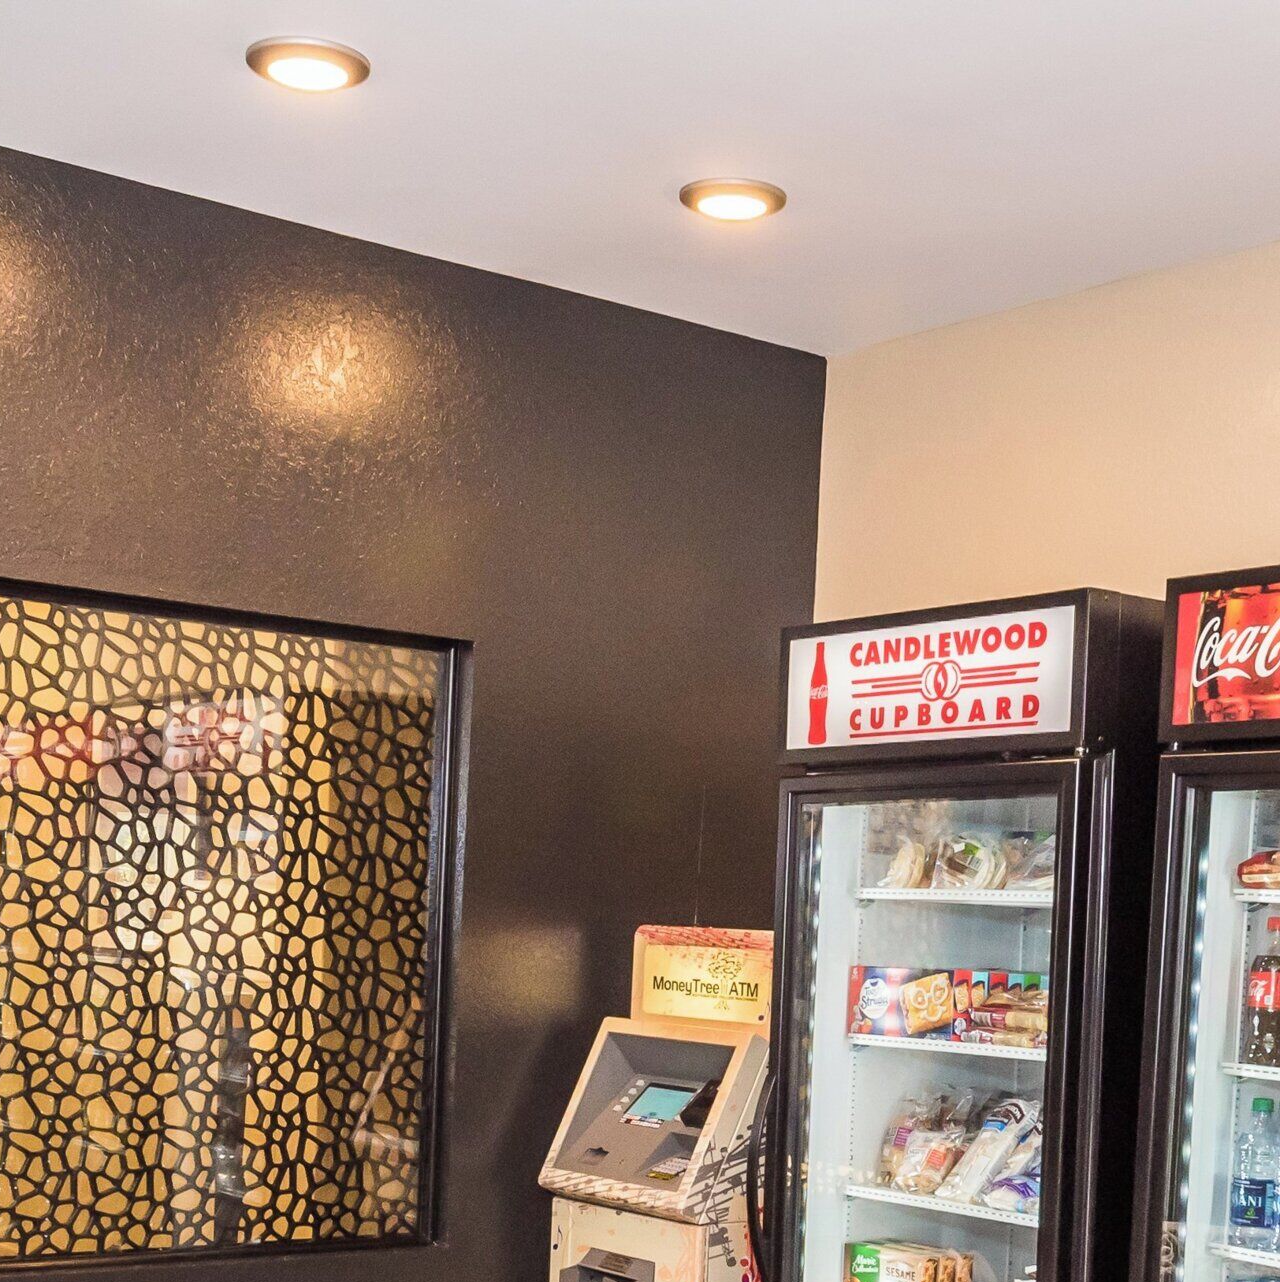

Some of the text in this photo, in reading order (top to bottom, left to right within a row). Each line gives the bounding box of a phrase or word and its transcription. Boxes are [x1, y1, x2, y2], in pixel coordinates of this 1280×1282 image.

[849, 620, 1048, 667] CANDLEWOOD
[849, 694, 1040, 731] CUPBOARD
[652, 975, 759, 998] MoneyTree ATM
[886, 1266, 916, 1282] SESAME
